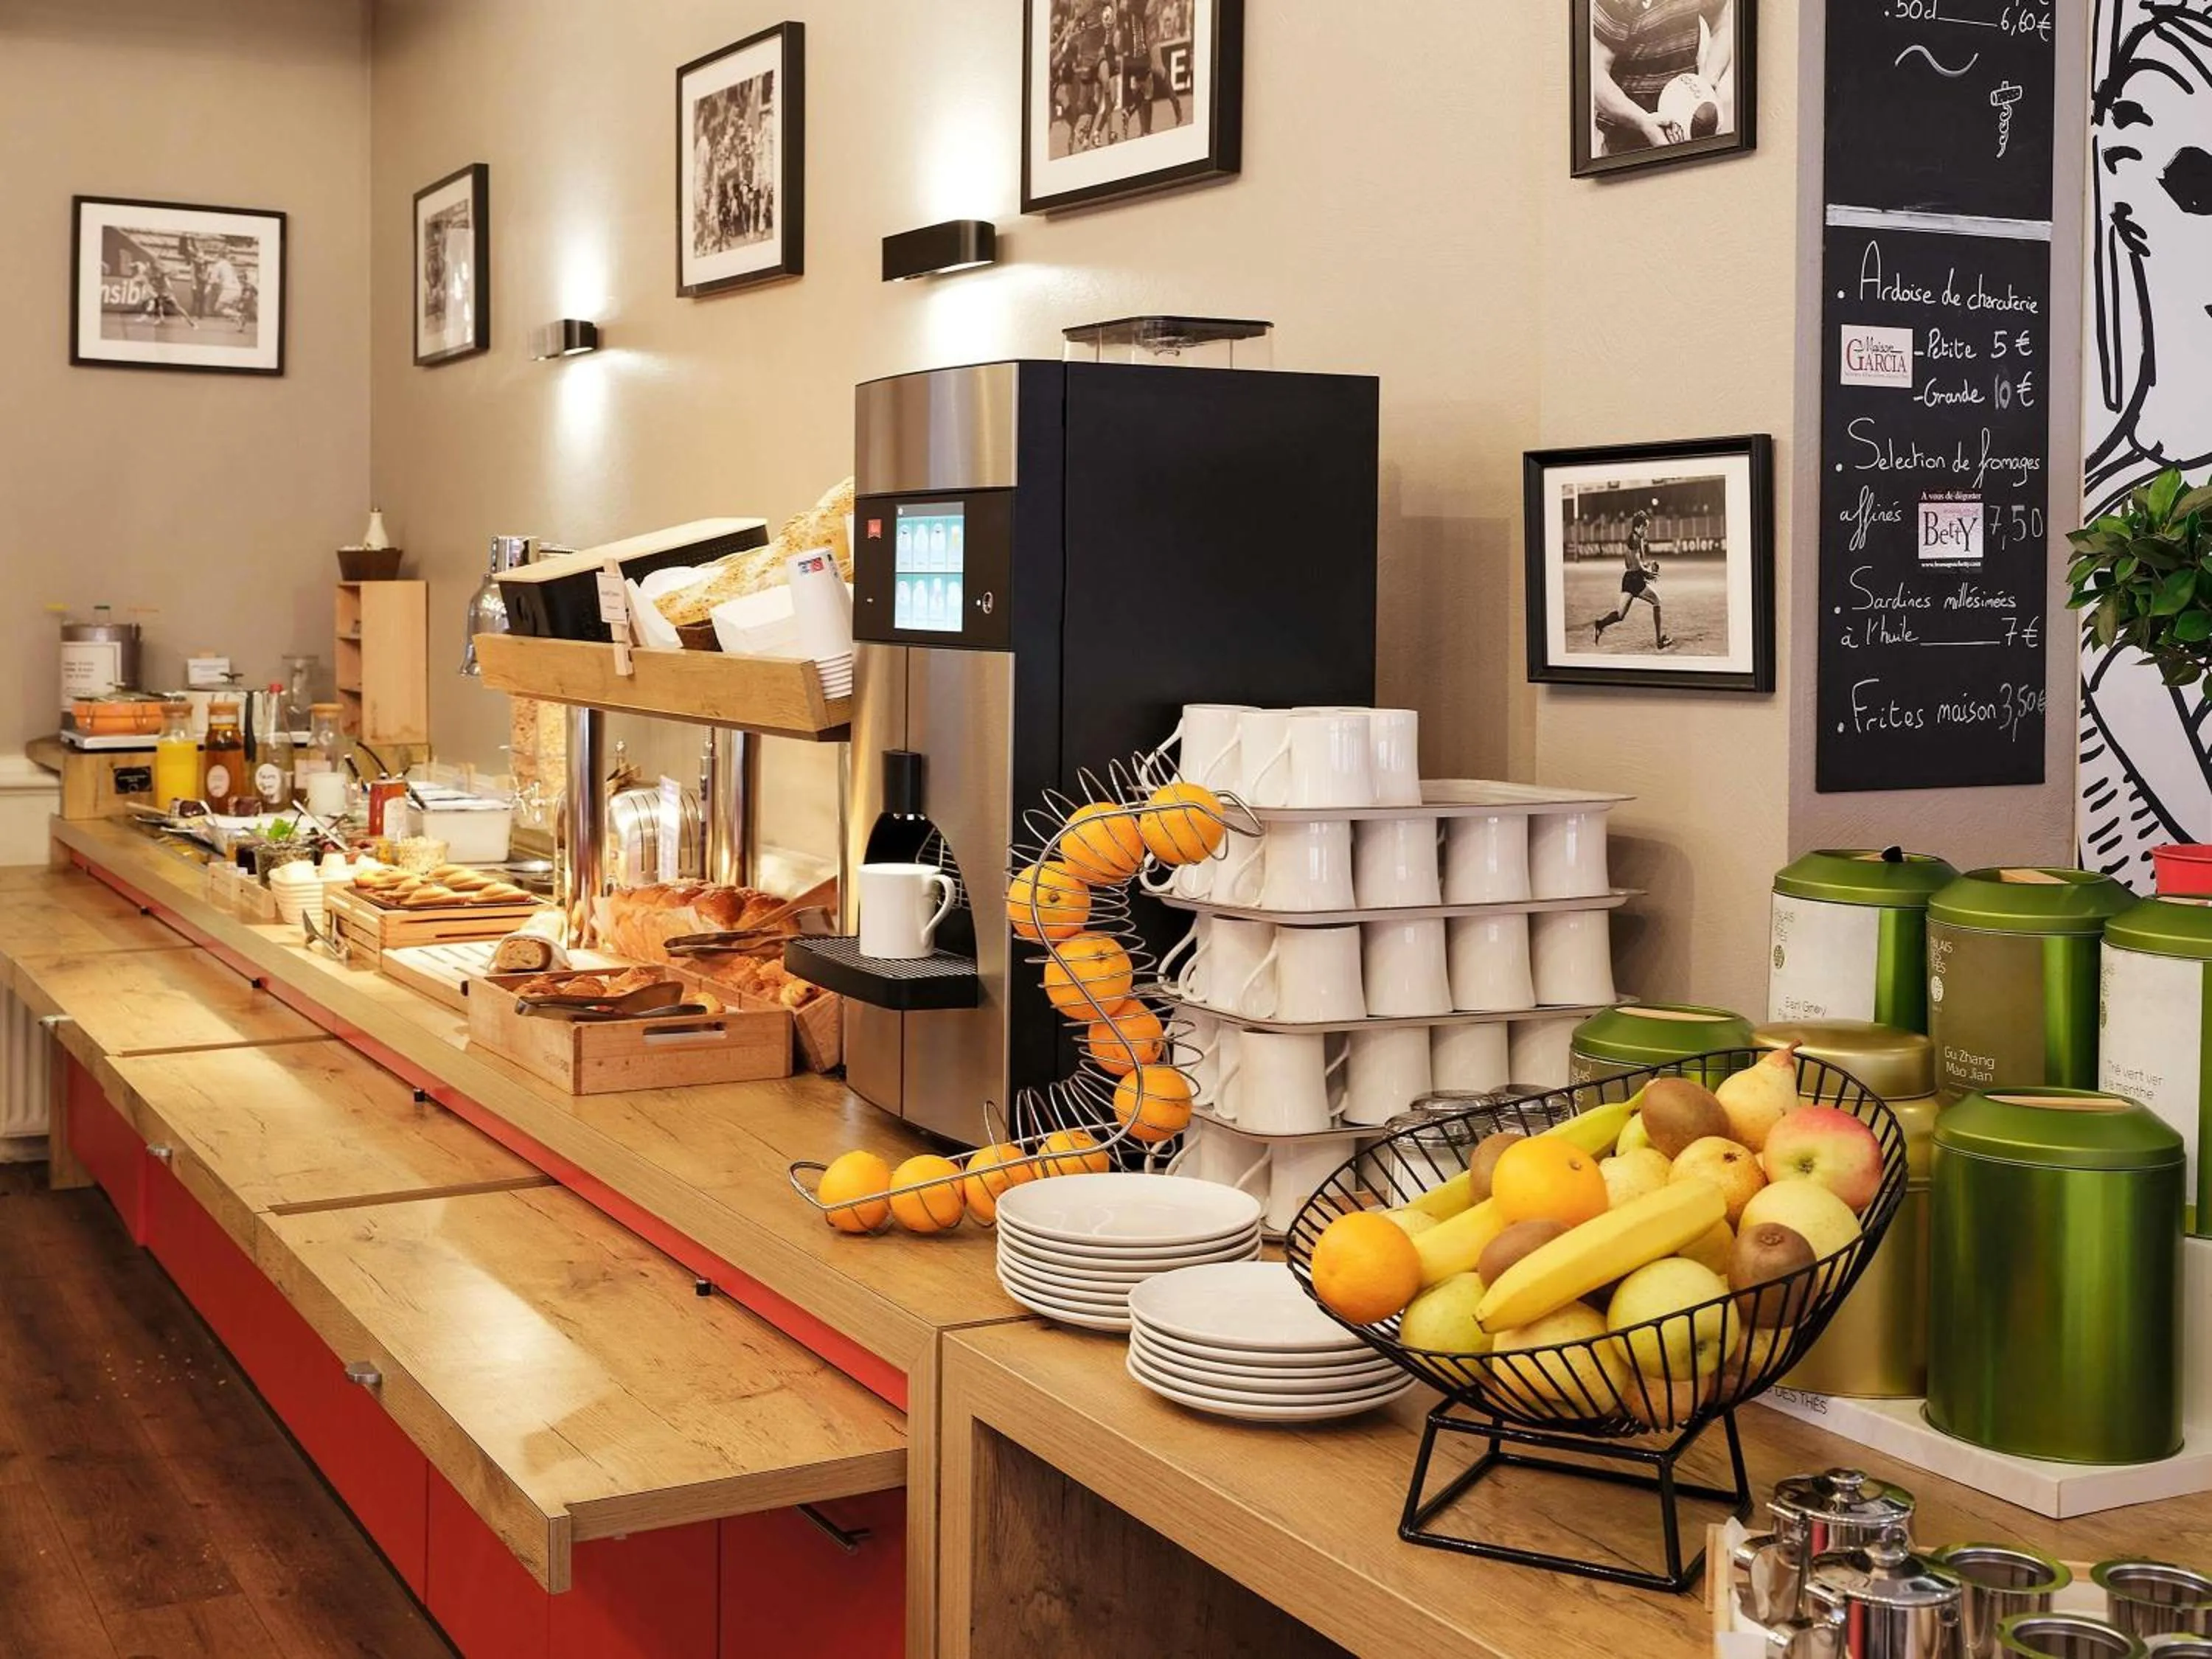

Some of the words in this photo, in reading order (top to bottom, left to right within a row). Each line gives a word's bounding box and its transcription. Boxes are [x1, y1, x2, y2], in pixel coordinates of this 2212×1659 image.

[1170, 48, 1192, 91] E
[1860, 240, 1935, 302] Ardoise
[1941, 268, 1961, 306] de
[1846, 338, 1906, 372] GARCIA
[1991, 330, 2008, 359] 5
[1993, 374, 2012, 410] 10
[1952, 442, 1970, 473] de
[1972, 427, 2040, 487] fromages
[1840, 484, 1902, 552] affinés
[1989, 504, 2044, 551] 7,50
[1850, 566, 1931, 611] Sardines
[1841, 627, 1859, 649] à
[1851, 678, 1924, 734] Frites
[1937, 692, 1997, 724] maison
